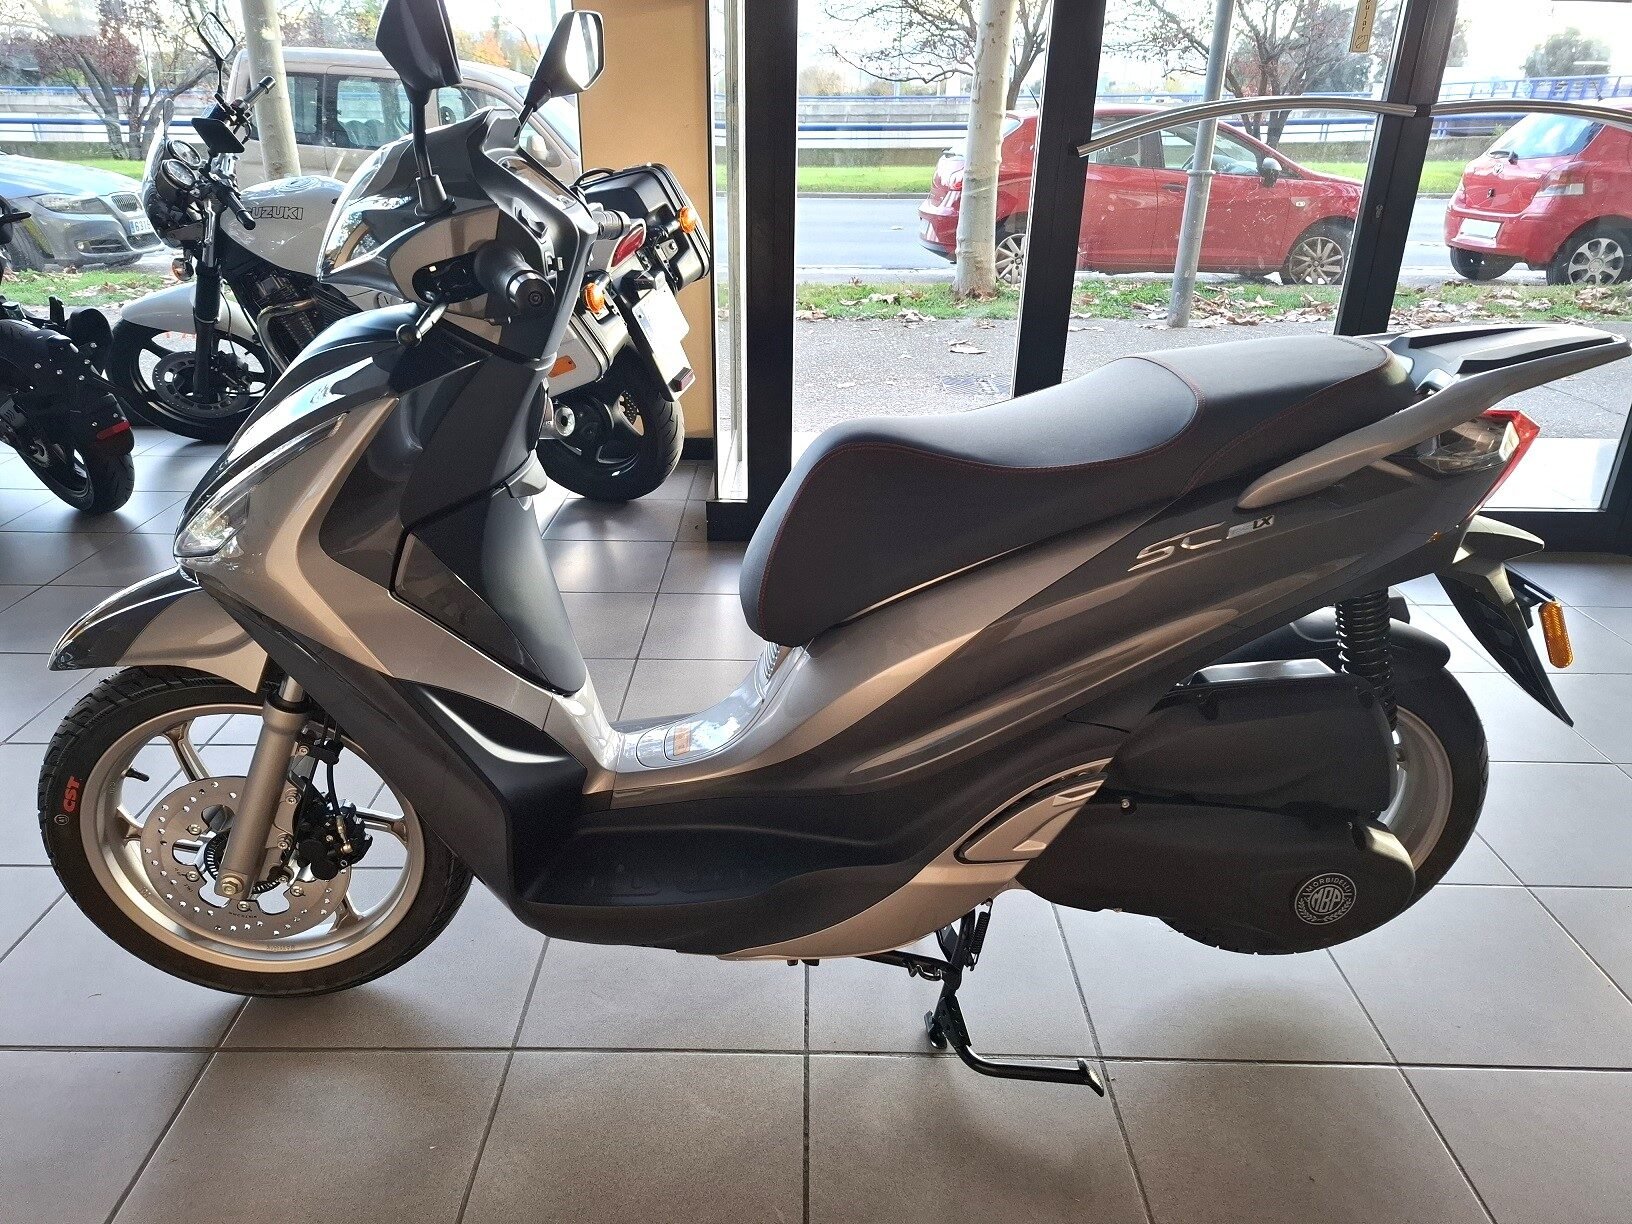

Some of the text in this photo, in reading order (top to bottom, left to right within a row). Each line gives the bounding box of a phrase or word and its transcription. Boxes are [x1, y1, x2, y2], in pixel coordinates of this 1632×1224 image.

[64, 776, 80, 812] CST
[1306, 877, 1352, 893] MORBIDELLI
[1311, 887, 1342, 913] MBP
